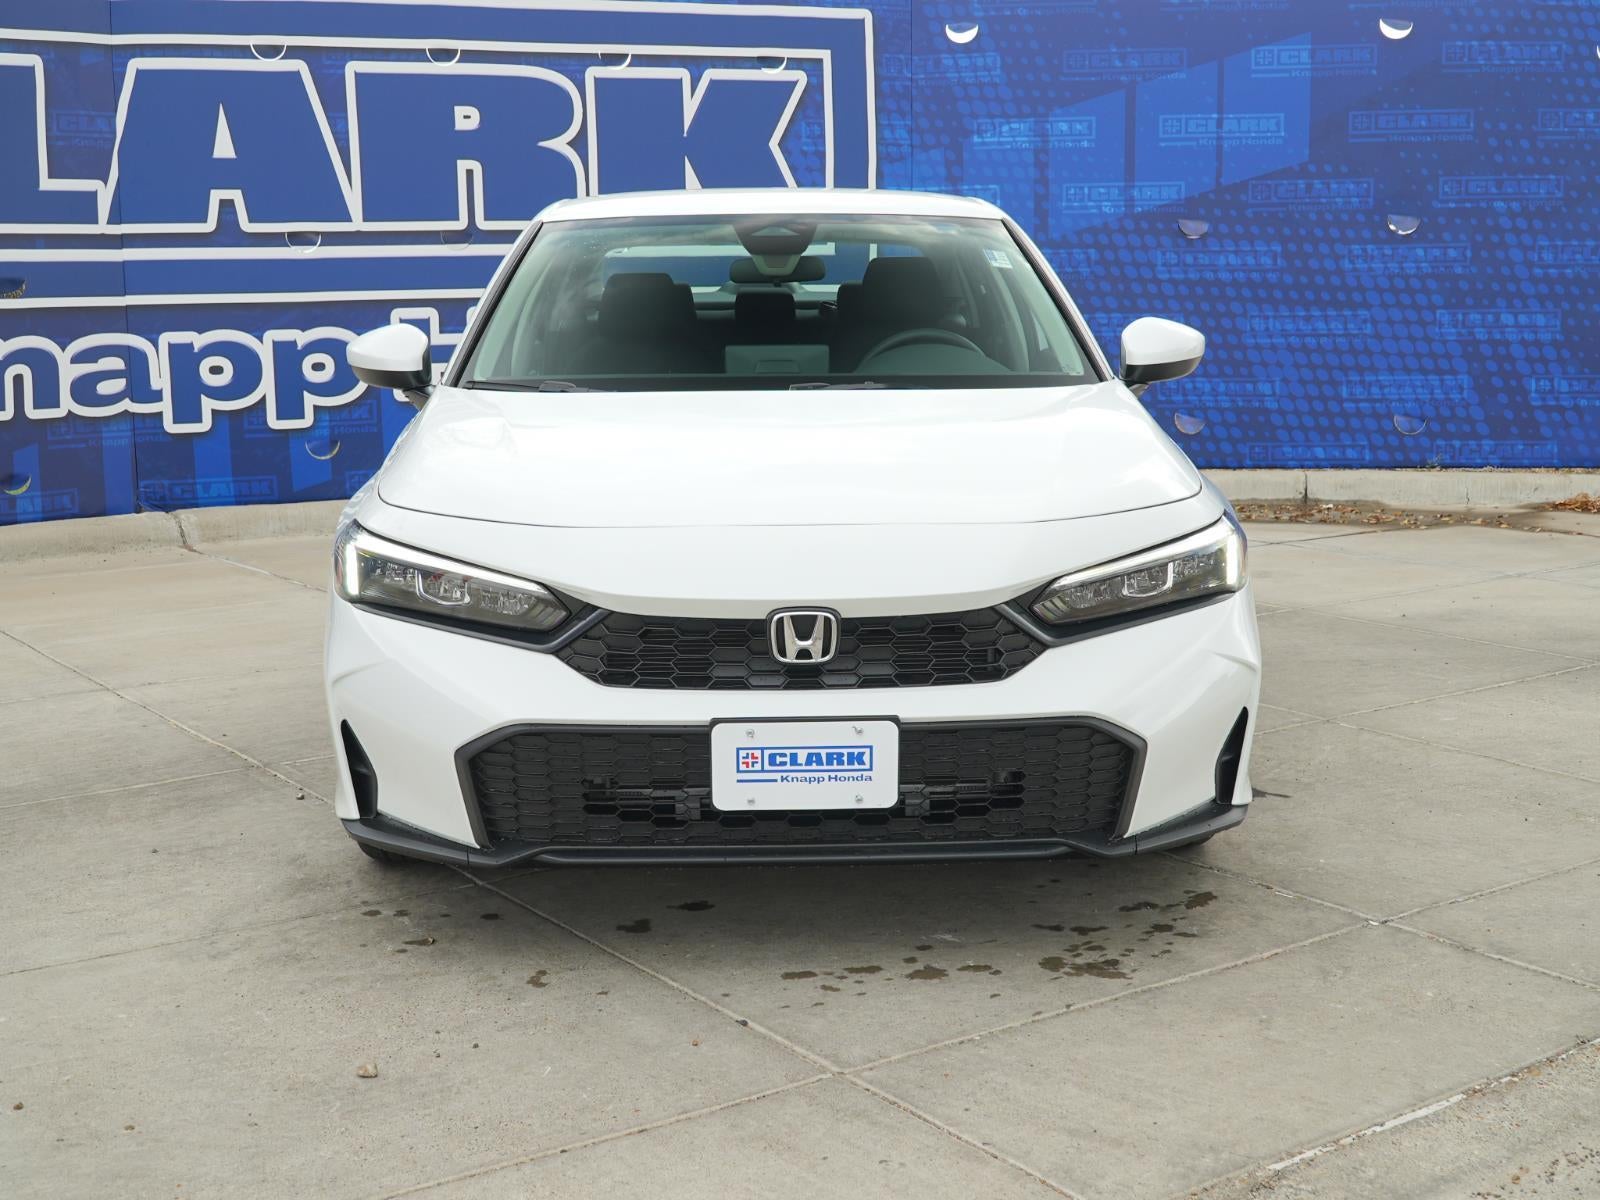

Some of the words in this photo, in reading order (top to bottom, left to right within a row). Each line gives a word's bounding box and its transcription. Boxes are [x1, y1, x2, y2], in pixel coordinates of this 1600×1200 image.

[1187, 119, 1279, 132] CLARK
[172, 481, 272, 499] CLARK
[768, 751, 866, 767] CLARK
[780, 775, 825, 784] Knapp
[828, 774, 873, 783] Honda
